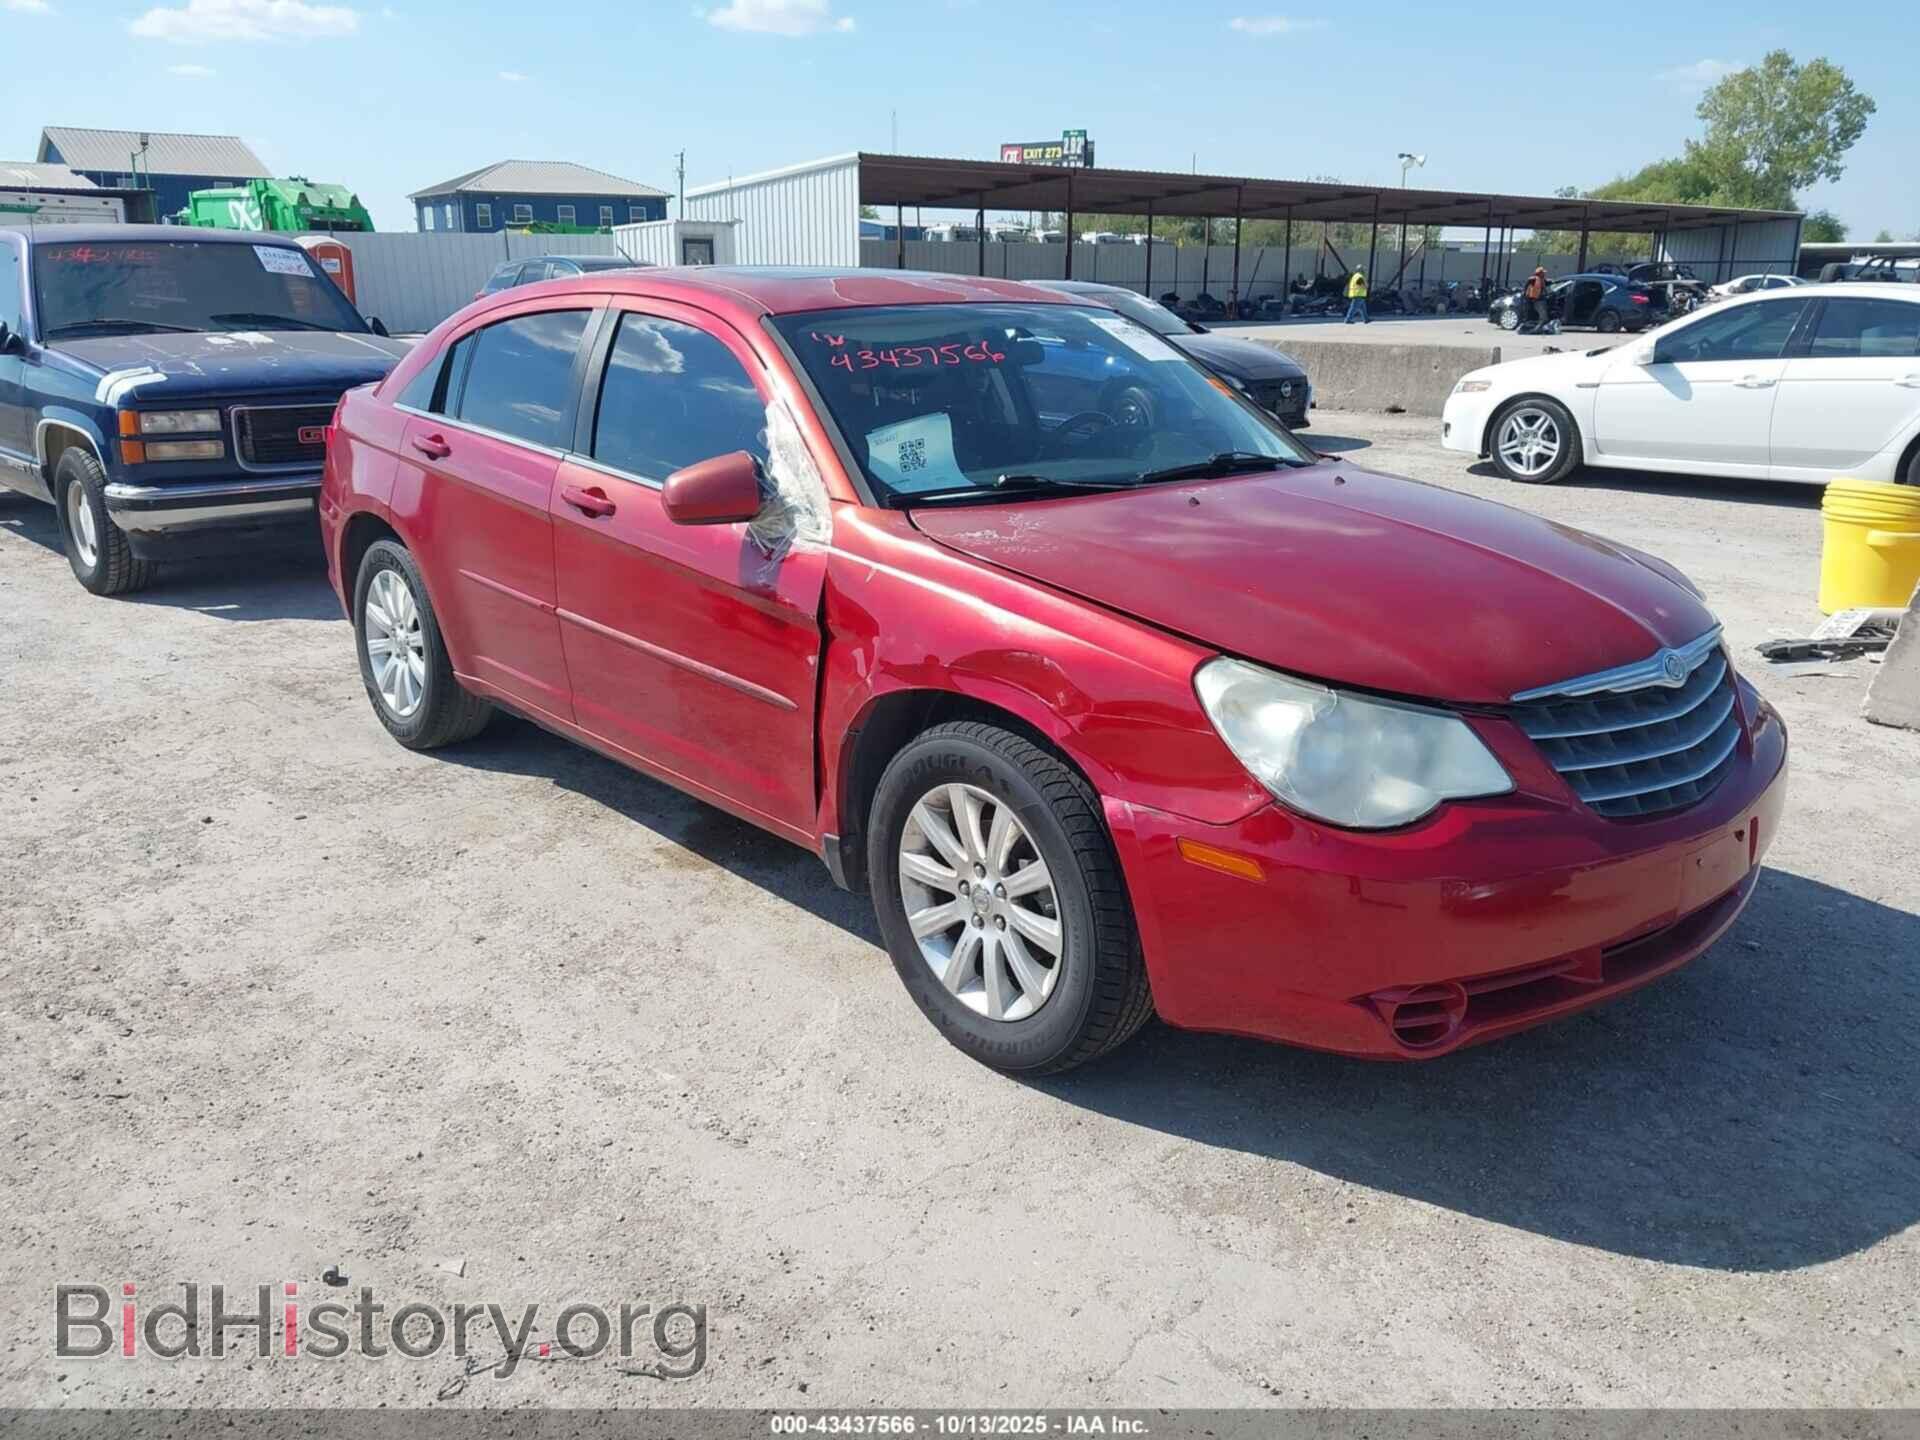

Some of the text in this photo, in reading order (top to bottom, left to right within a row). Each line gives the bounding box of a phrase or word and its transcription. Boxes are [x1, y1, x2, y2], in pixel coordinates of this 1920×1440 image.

[1023, 146, 1062, 160] EXIT 273
[831, 341, 1006, 372] 43437566
